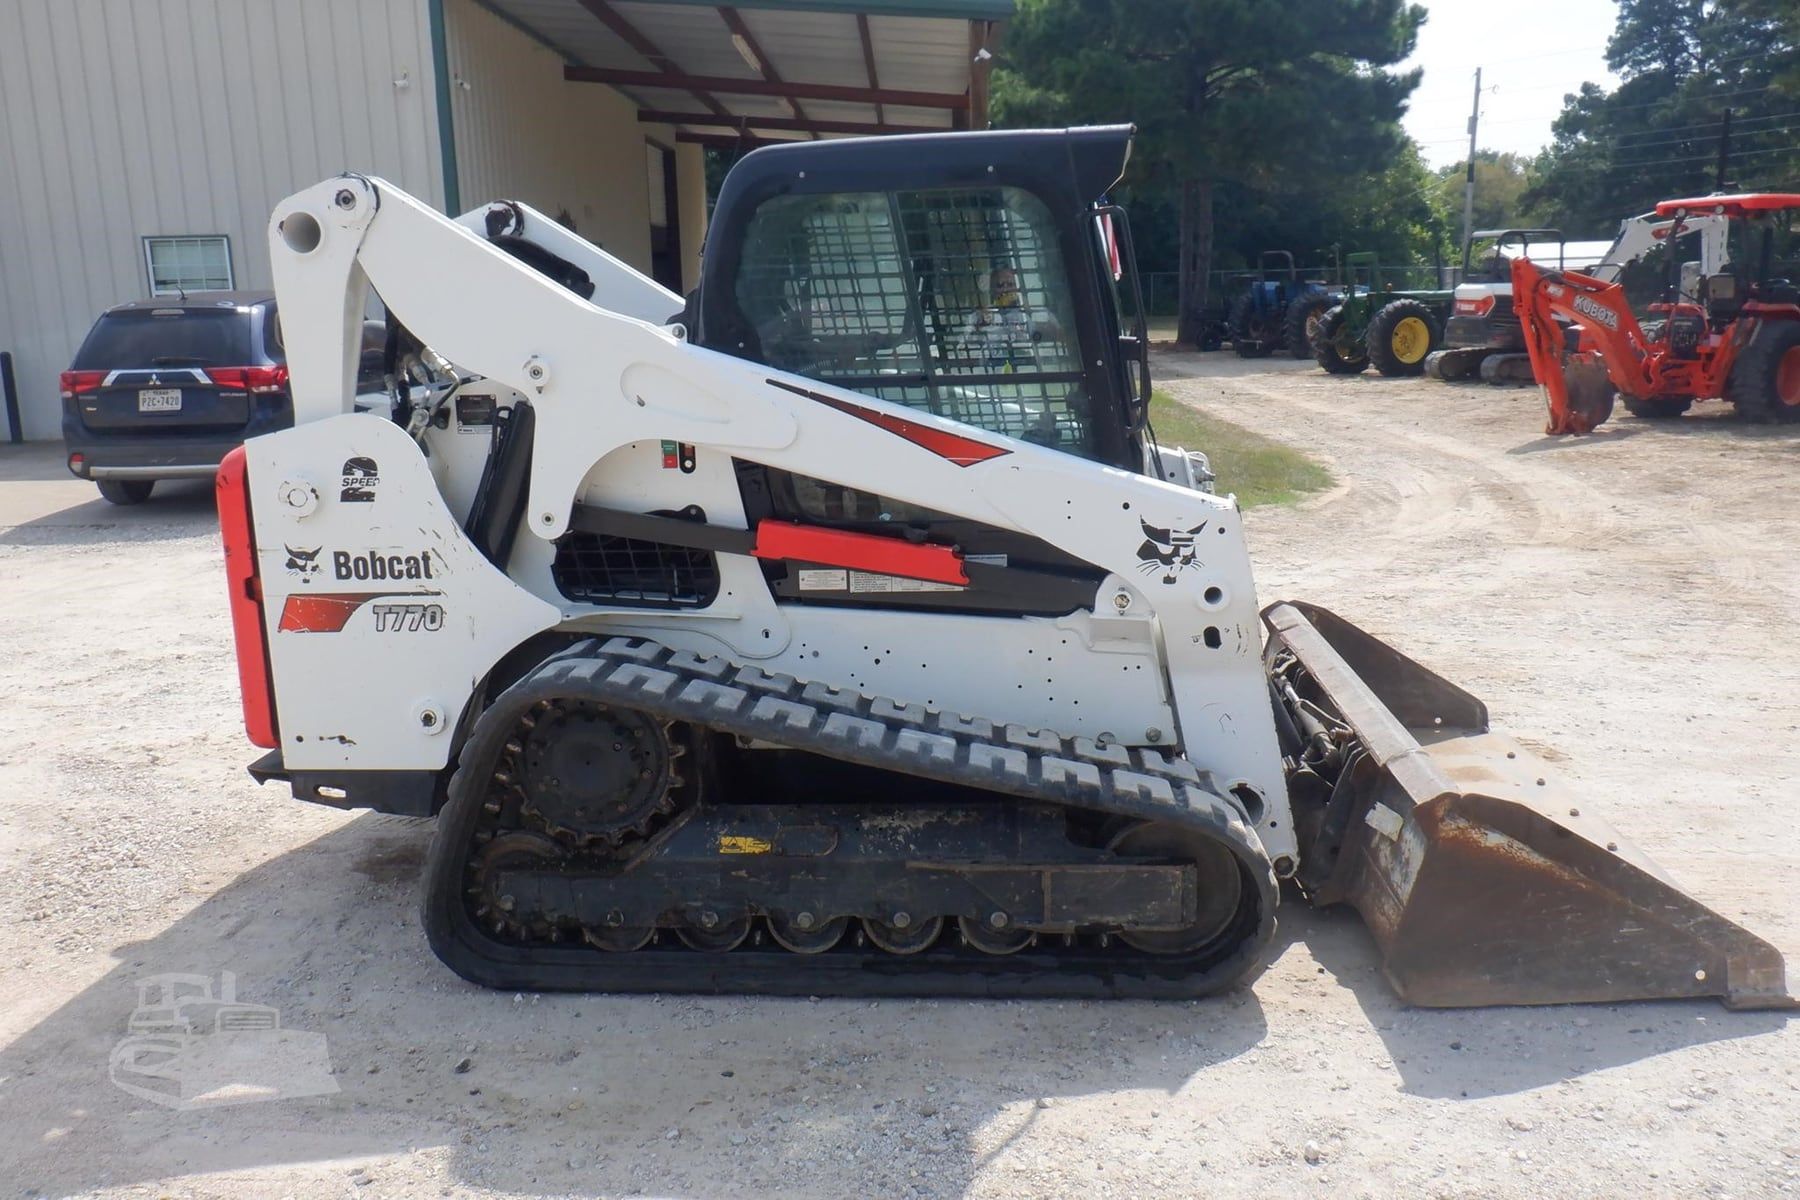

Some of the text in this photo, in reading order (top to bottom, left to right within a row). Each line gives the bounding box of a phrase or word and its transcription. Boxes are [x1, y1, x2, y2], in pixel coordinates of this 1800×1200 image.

[1573, 294, 1618, 331] KUBOTA
[333, 551, 433, 580] Bobcat
[372, 604, 444, 632] T770
